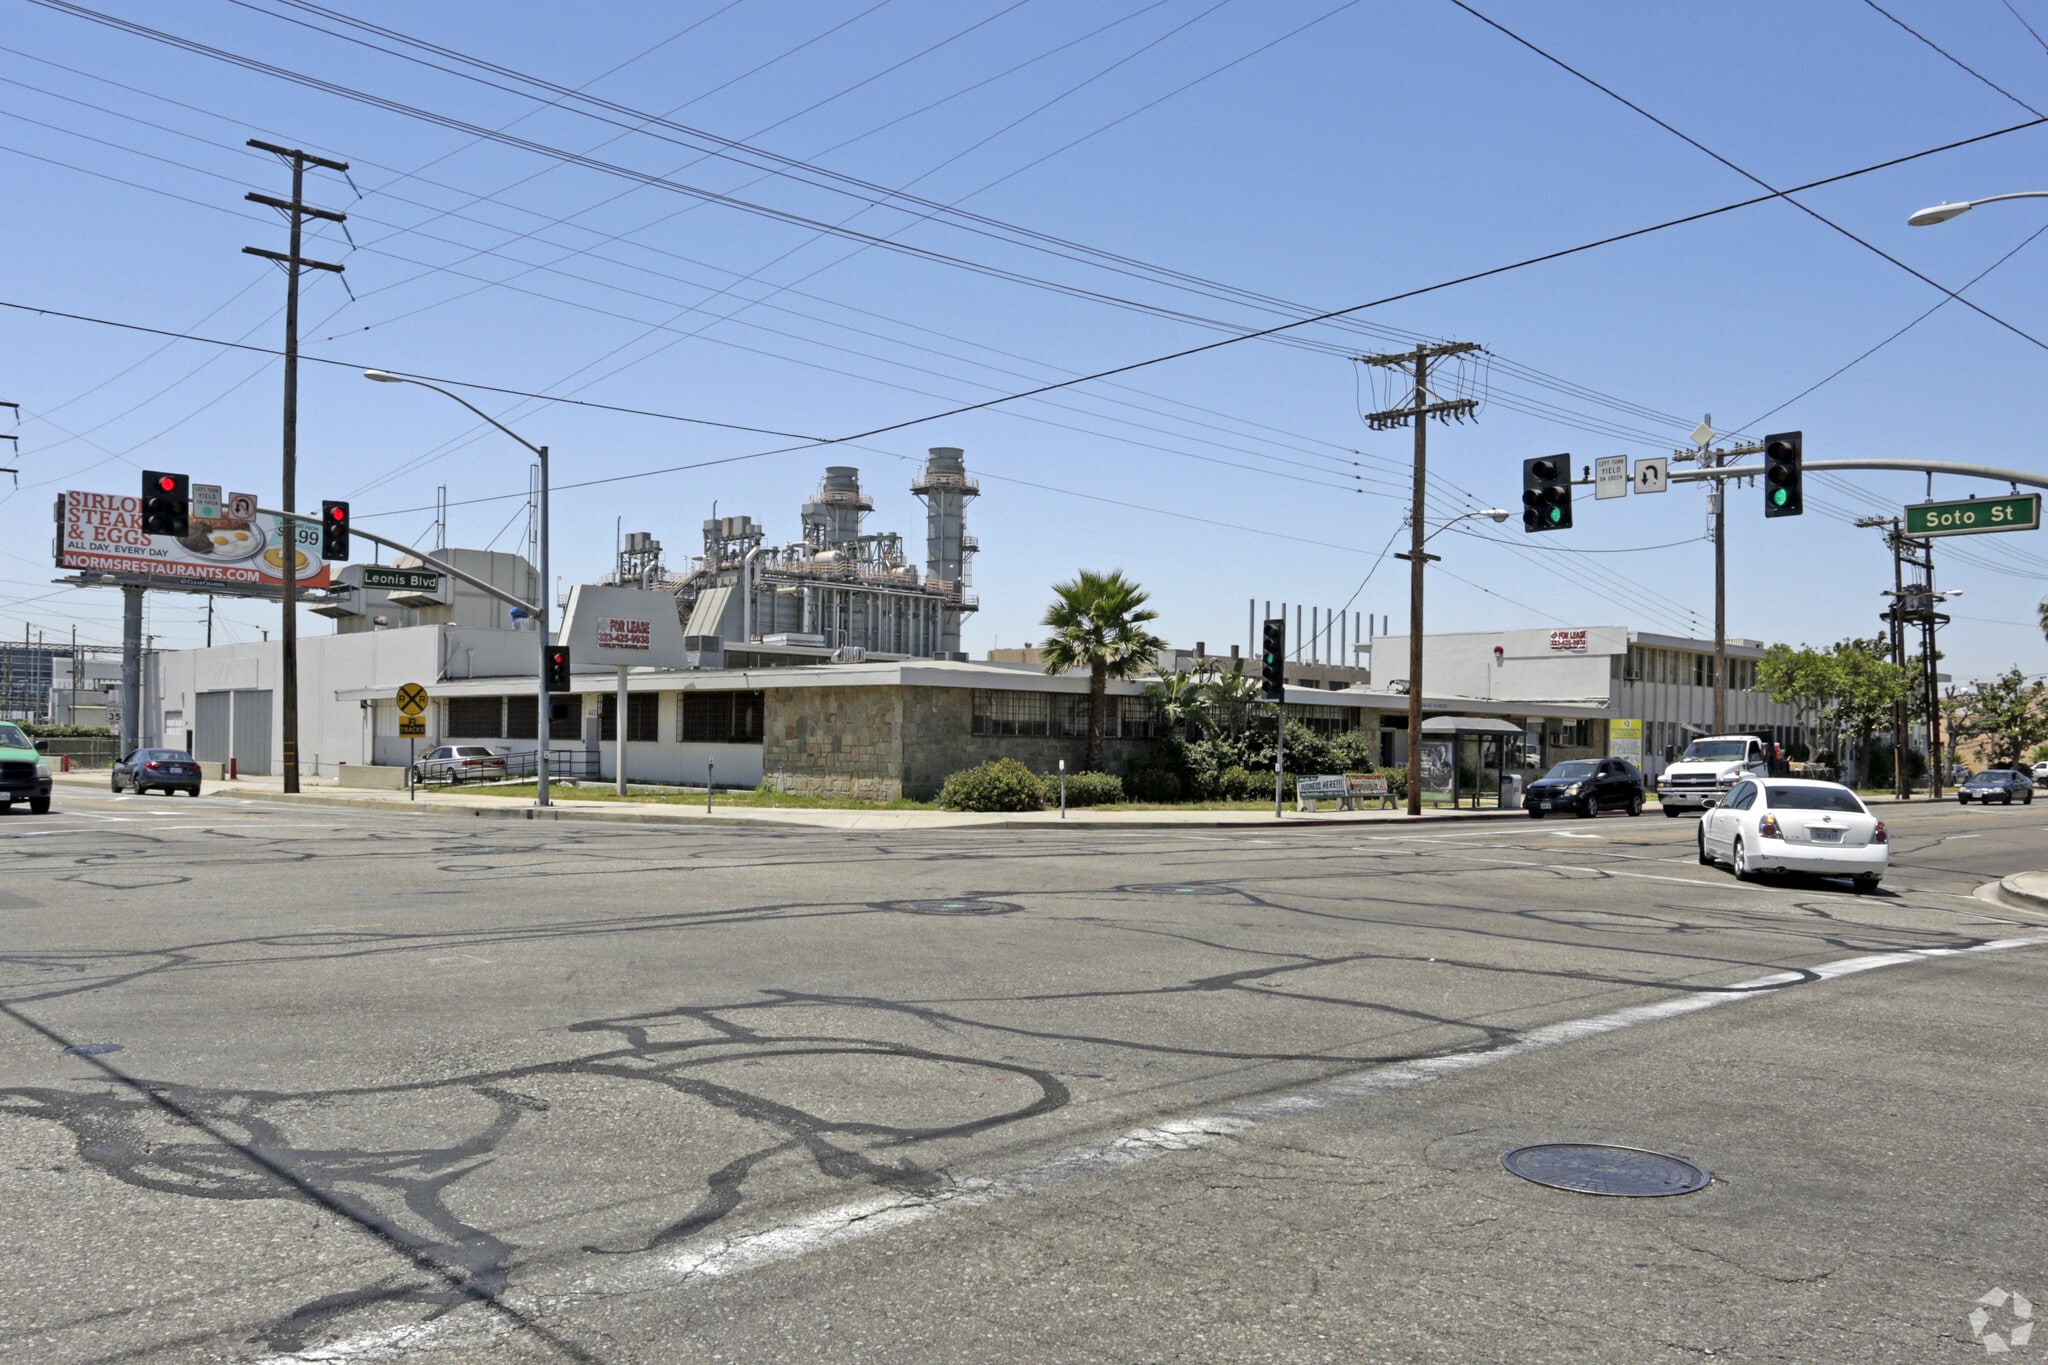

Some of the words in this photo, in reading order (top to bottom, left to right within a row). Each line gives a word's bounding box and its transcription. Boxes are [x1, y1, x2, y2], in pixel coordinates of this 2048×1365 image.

[1602, 467, 1621, 475] YIELD
[1926, 510, 1975, 527] Soto
[1991, 505, 2013, 521] St
[68, 524, 84, 540] &
[93, 525, 152, 547] EGGS
[68, 541, 87, 550] ALL
[89, 543, 111, 553] DAY,
[114, 545, 146, 555] EVERY
[148, 548, 169, 557] DAY
[63, 554, 260, 582] NORMSRESTAURANTS.COM
[365, 572, 405, 585] Leonis
[411, 575, 436, 587] Blvd
[610, 619, 625, 632] FOR
[626, 620, 650, 634] LEASE
[1570, 630, 1587, 639] LEASE
[108, 712, 121, 721] 35
